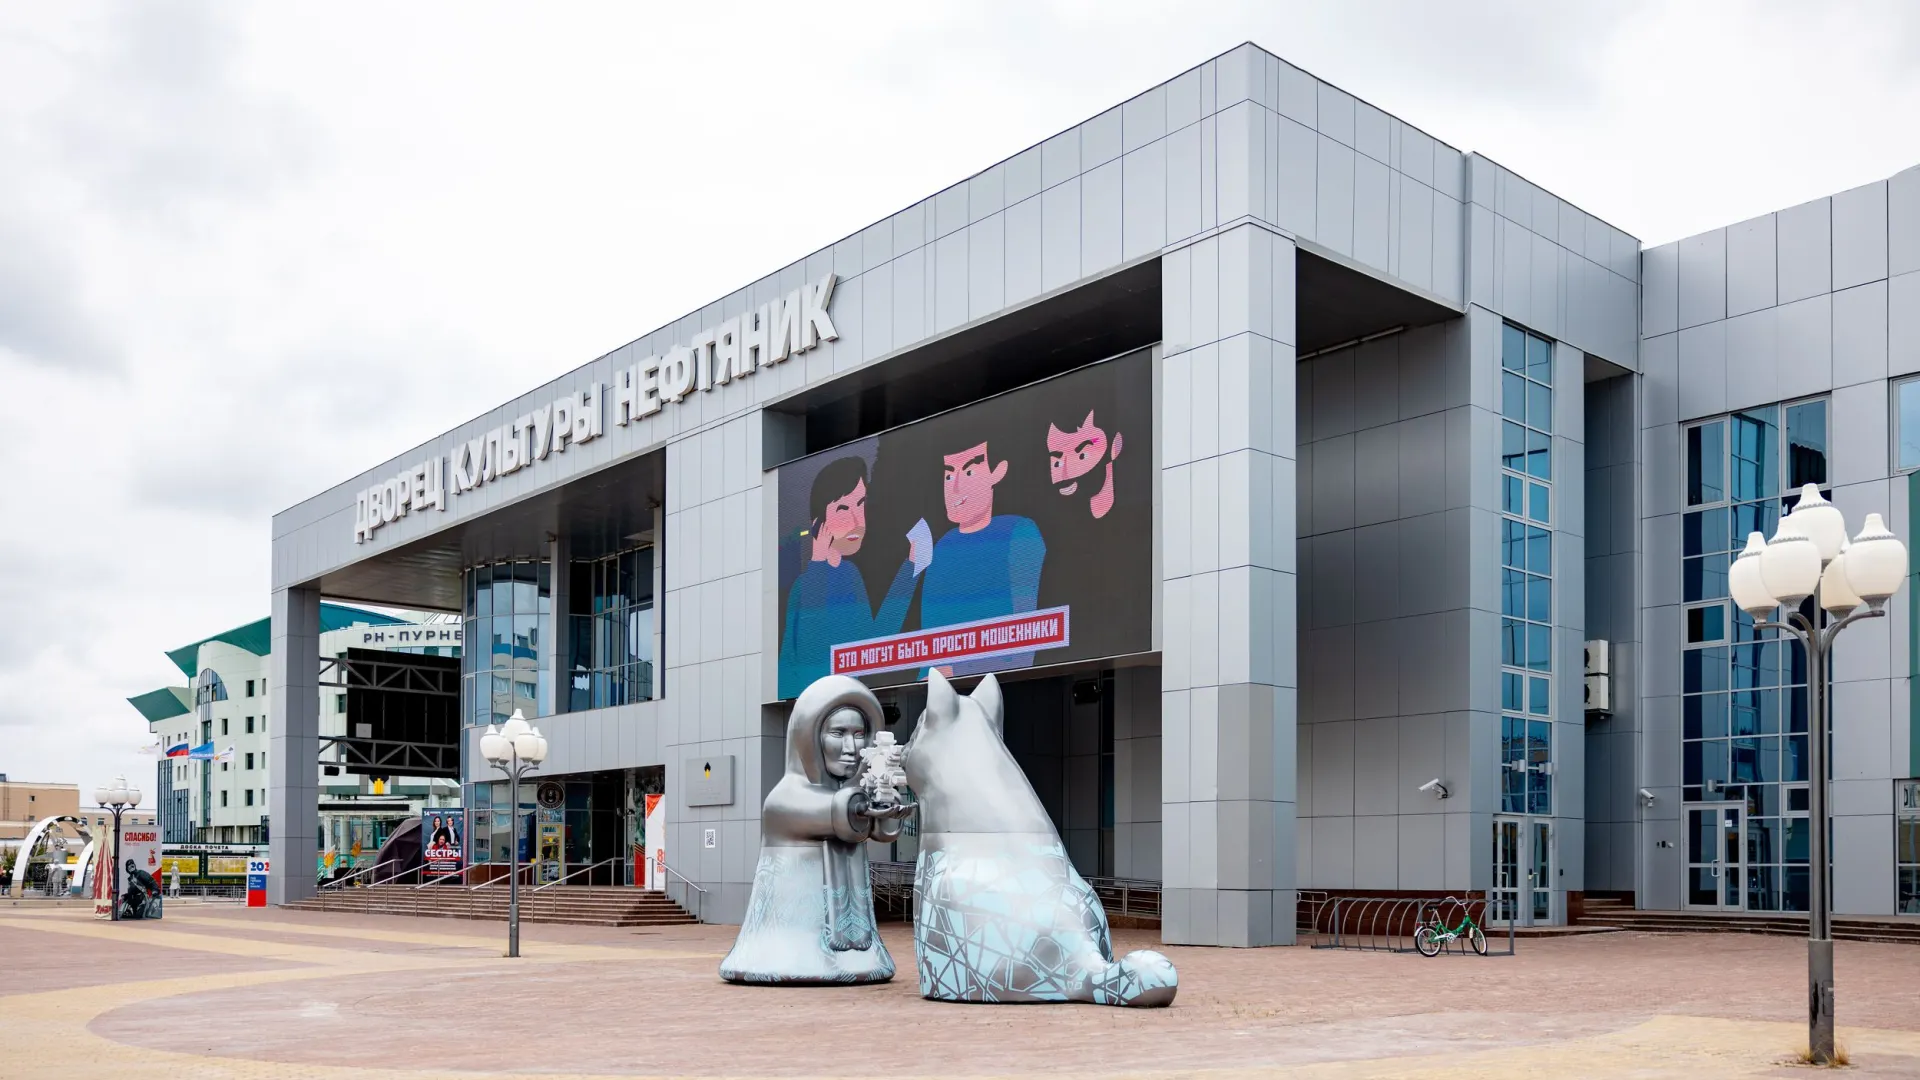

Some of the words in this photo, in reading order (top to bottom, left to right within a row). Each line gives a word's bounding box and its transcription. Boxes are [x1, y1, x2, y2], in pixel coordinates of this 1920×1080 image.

[354, 456, 446, 544] ДВОРЕЦ
[451, 382, 604, 495] КУЛЬТУРЫ
[615, 272, 839, 426] НЕФТЯНИК
[838, 651, 858, 669] ЭТО
[861, 644, 894, 665] МОГУТ
[897, 640, 929, 660] БЫТЬ
[932, 631, 977, 654] ПРОСТО
[980, 617, 1059, 647] МОШЕННИКИ
[124, 832, 157, 842] СПАСИБО!
[424, 849, 462, 857] СЕСТРЫ
